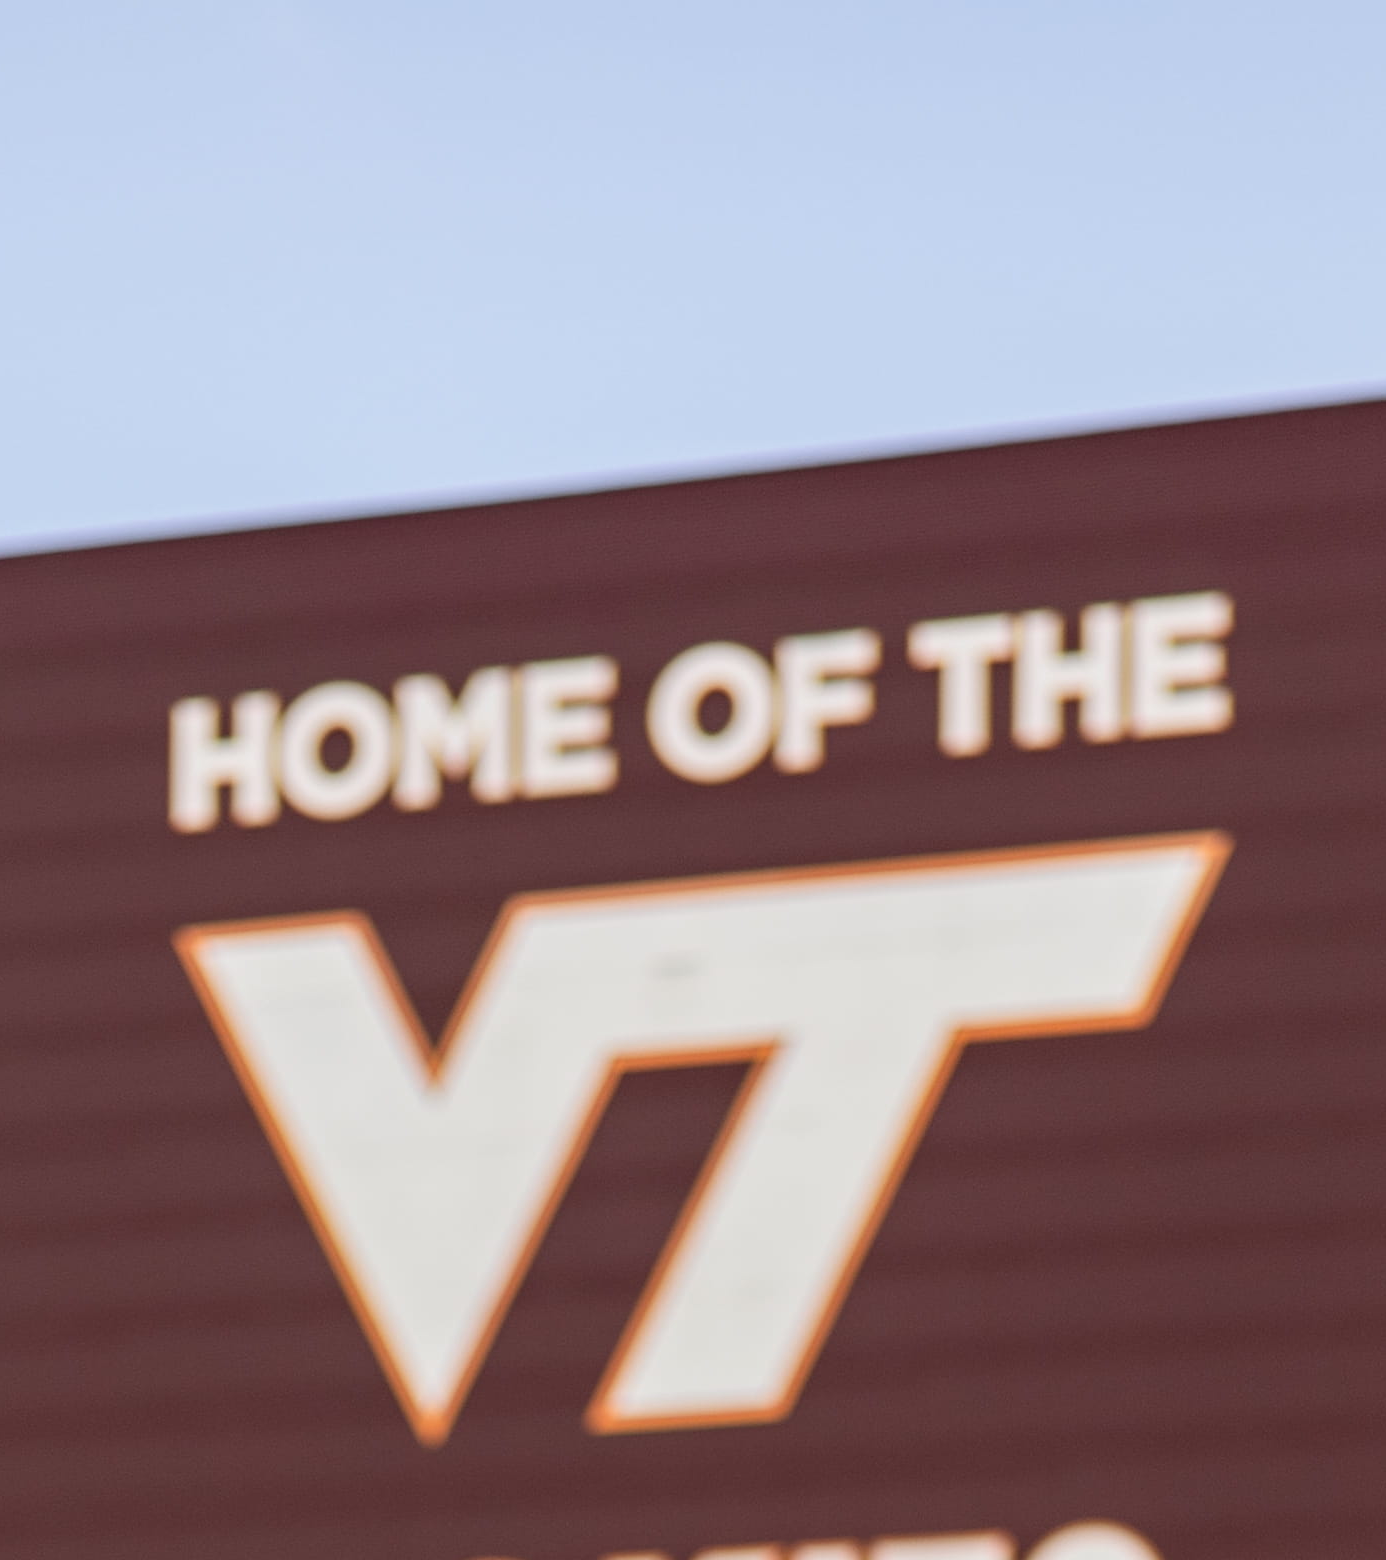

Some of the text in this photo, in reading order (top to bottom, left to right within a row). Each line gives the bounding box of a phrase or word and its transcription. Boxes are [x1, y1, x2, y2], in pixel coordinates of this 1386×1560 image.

[169, 592, 1234, 832] HOME OF THE
[173, 828, 1235, 1447] VT
